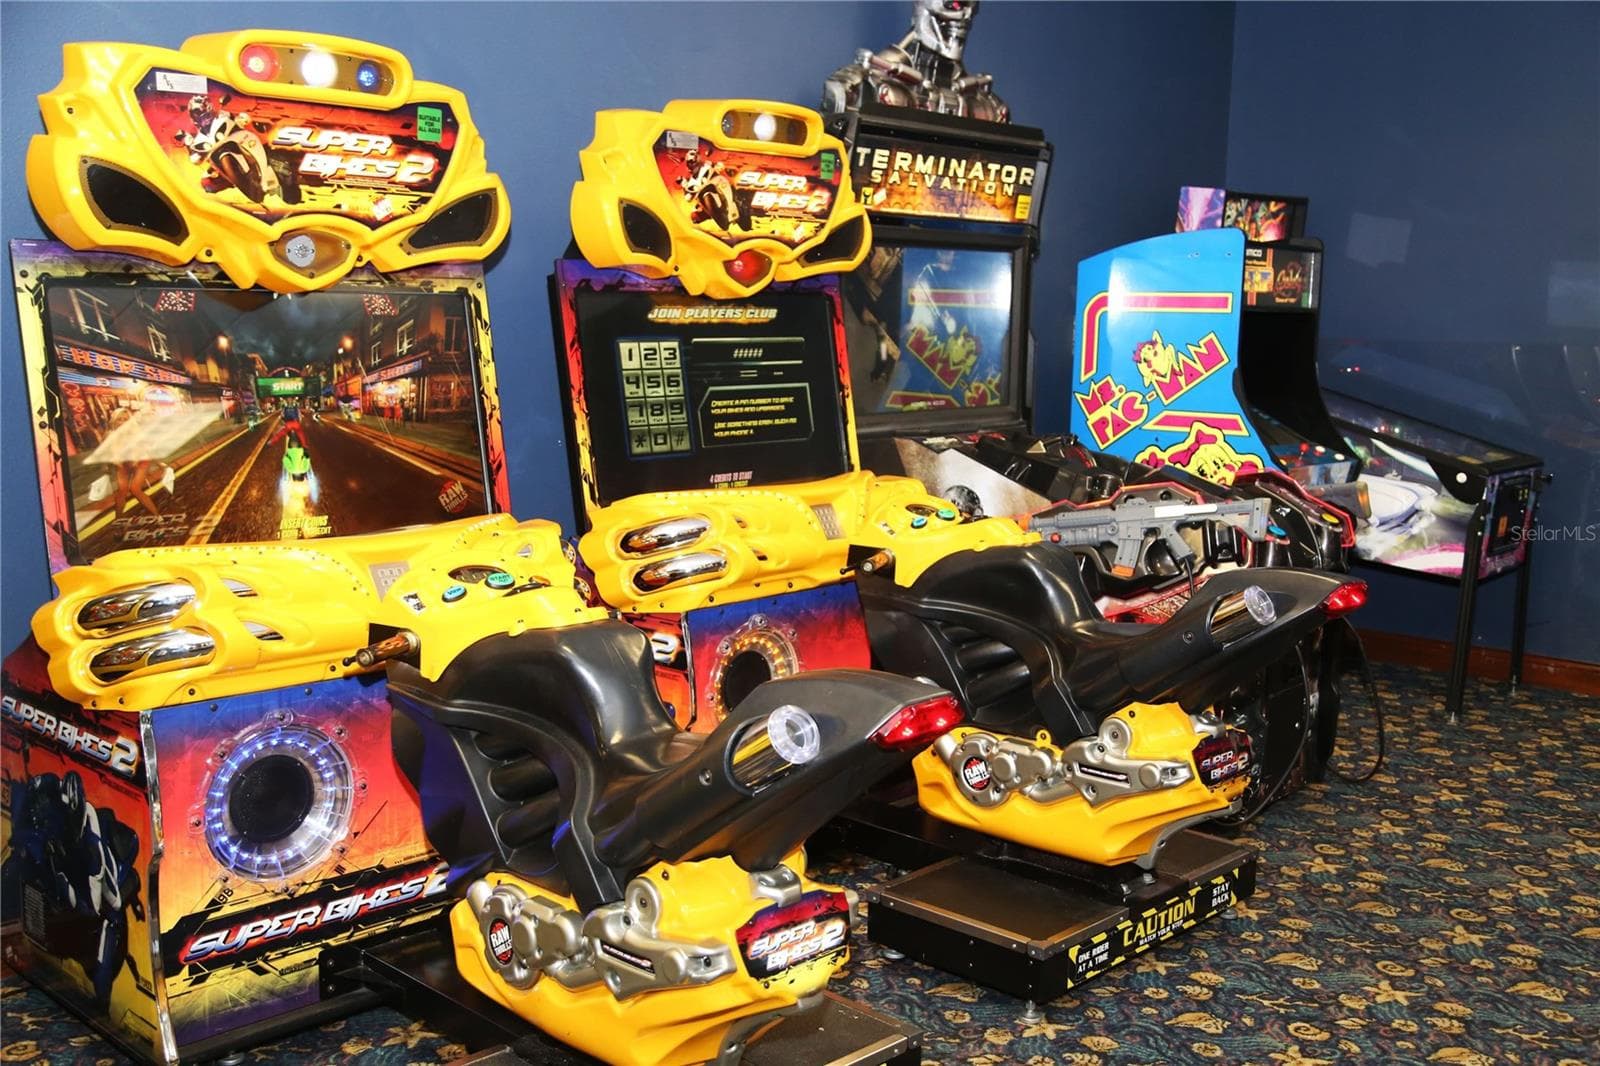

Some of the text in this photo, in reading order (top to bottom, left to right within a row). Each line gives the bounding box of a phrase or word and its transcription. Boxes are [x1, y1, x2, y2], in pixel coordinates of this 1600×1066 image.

[418, 114, 441, 123] SUITABLE
[271, 126, 394, 154] SUPER
[298, 153, 436, 183] BIKES 2
[856, 146, 1035, 186] TERMINATOR
[736, 171, 808, 191] SUPER
[870, 169, 1015, 197] SALVATION
[751, 188, 832, 213] BIKES 2
[648, 308, 778, 319] JOIN PLAYERS CLUB
[627, 347, 677, 361] 1 2 3
[272, 381, 304, 392] START
[625, 375, 681, 389] 4 5 6
[629, 402, 684, 417] 7 8 9
[438, 481, 463, 506] RAW
[650, 632, 677, 664] 2
[1, 695, 139, 778] SUPER BIKES 2
[964, 761, 987, 780] RAW
[1200, 751, 1233, 771] SUPER
[1238, 752, 1250, 770] 2
[1211, 892, 1230, 907] BACK
[1212, 881, 1231, 897] STAY
[182, 904, 322, 962] SUPER
[322, 875, 428, 921] BIKES
[1122, 896, 1196, 948] CAUTION
[490, 925, 510, 948] RAW
[748, 920, 816, 960] SUPER
[766, 917, 846, 972] BIKES 2
[1139, 935, 1157, 946] WATCH
[1157, 926, 1171, 936] YOUR
[1077, 951, 1109, 974] AT A TIME
[1078, 941, 1110, 964] ONE RIDER
